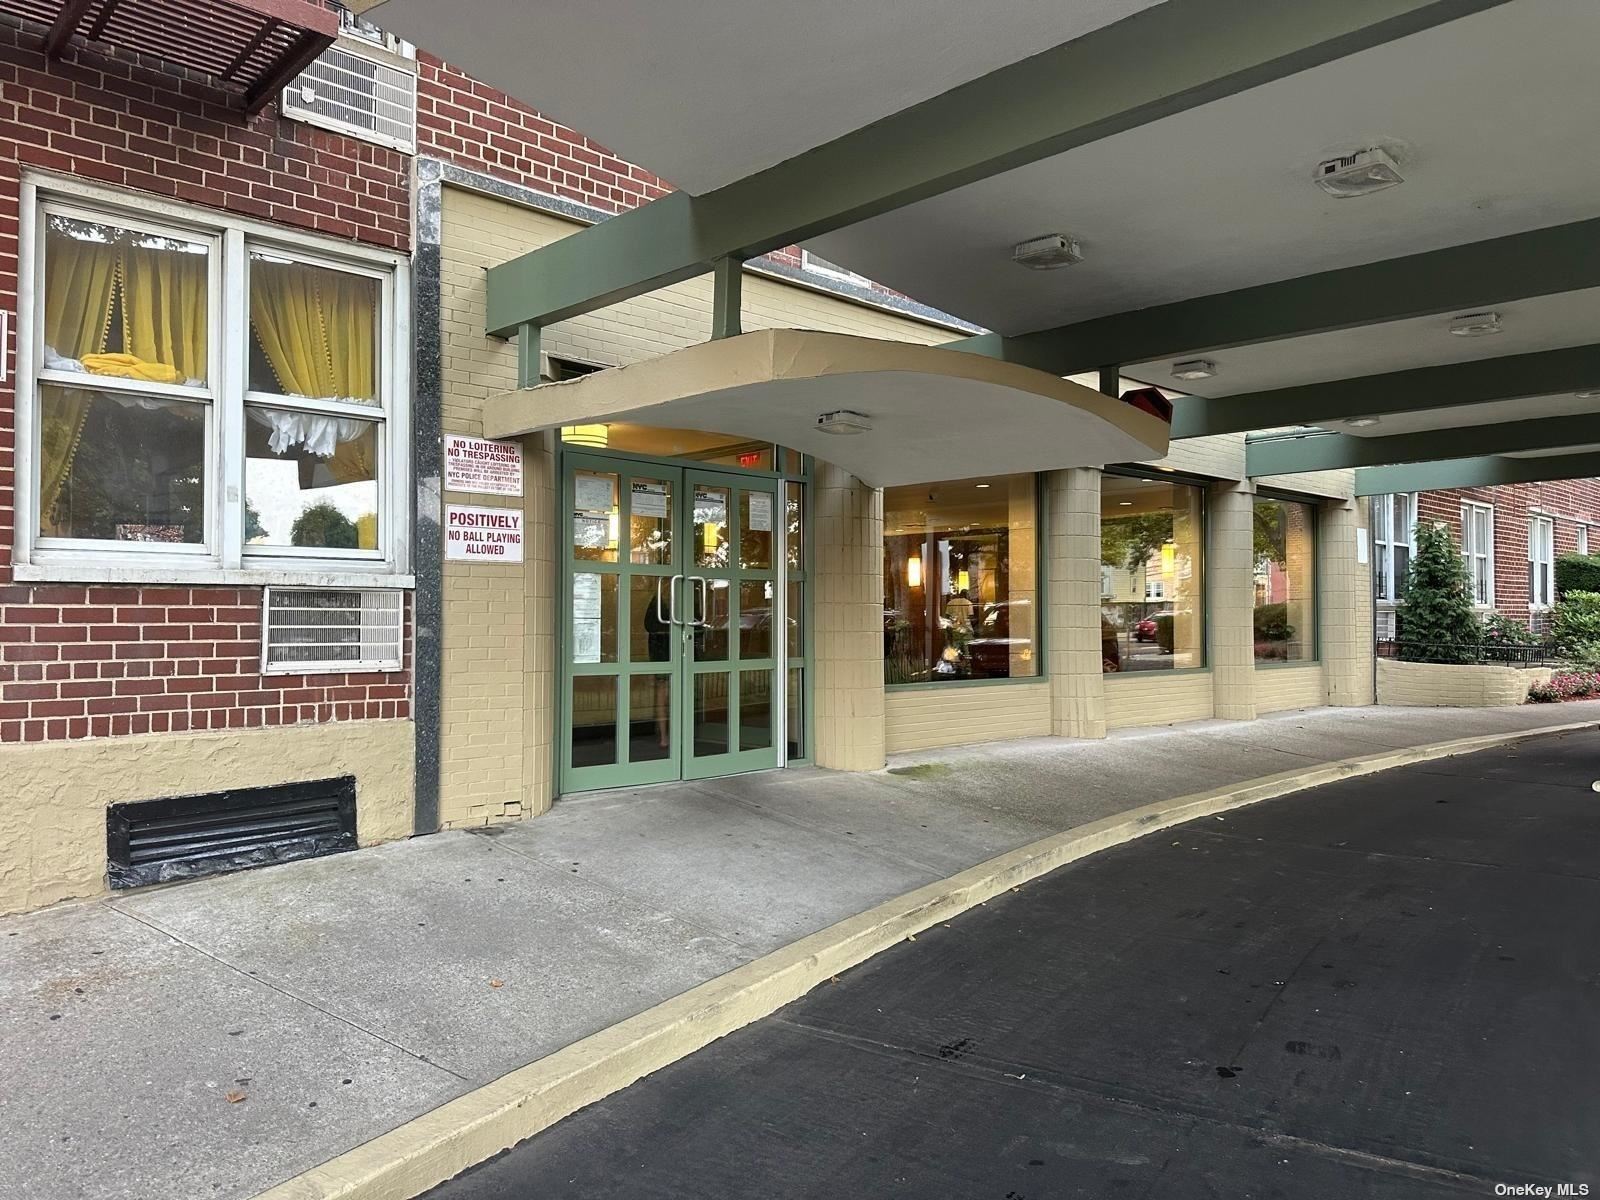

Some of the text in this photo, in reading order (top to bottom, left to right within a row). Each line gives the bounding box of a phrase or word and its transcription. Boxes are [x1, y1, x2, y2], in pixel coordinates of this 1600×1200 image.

[453, 440, 515, 455] NO LOITERING
[448, 448, 520, 463] NO TRESPASSING
[461, 472, 482, 480] POLICE
[483, 474, 520, 484] DEPARTMENT
[632, 482, 647, 490] NYC
[450, 512, 519, 528] POSITIVELY
[448, 530, 521, 544] NO BALL PLAYING
[466, 544, 505, 555] ALLOWED
